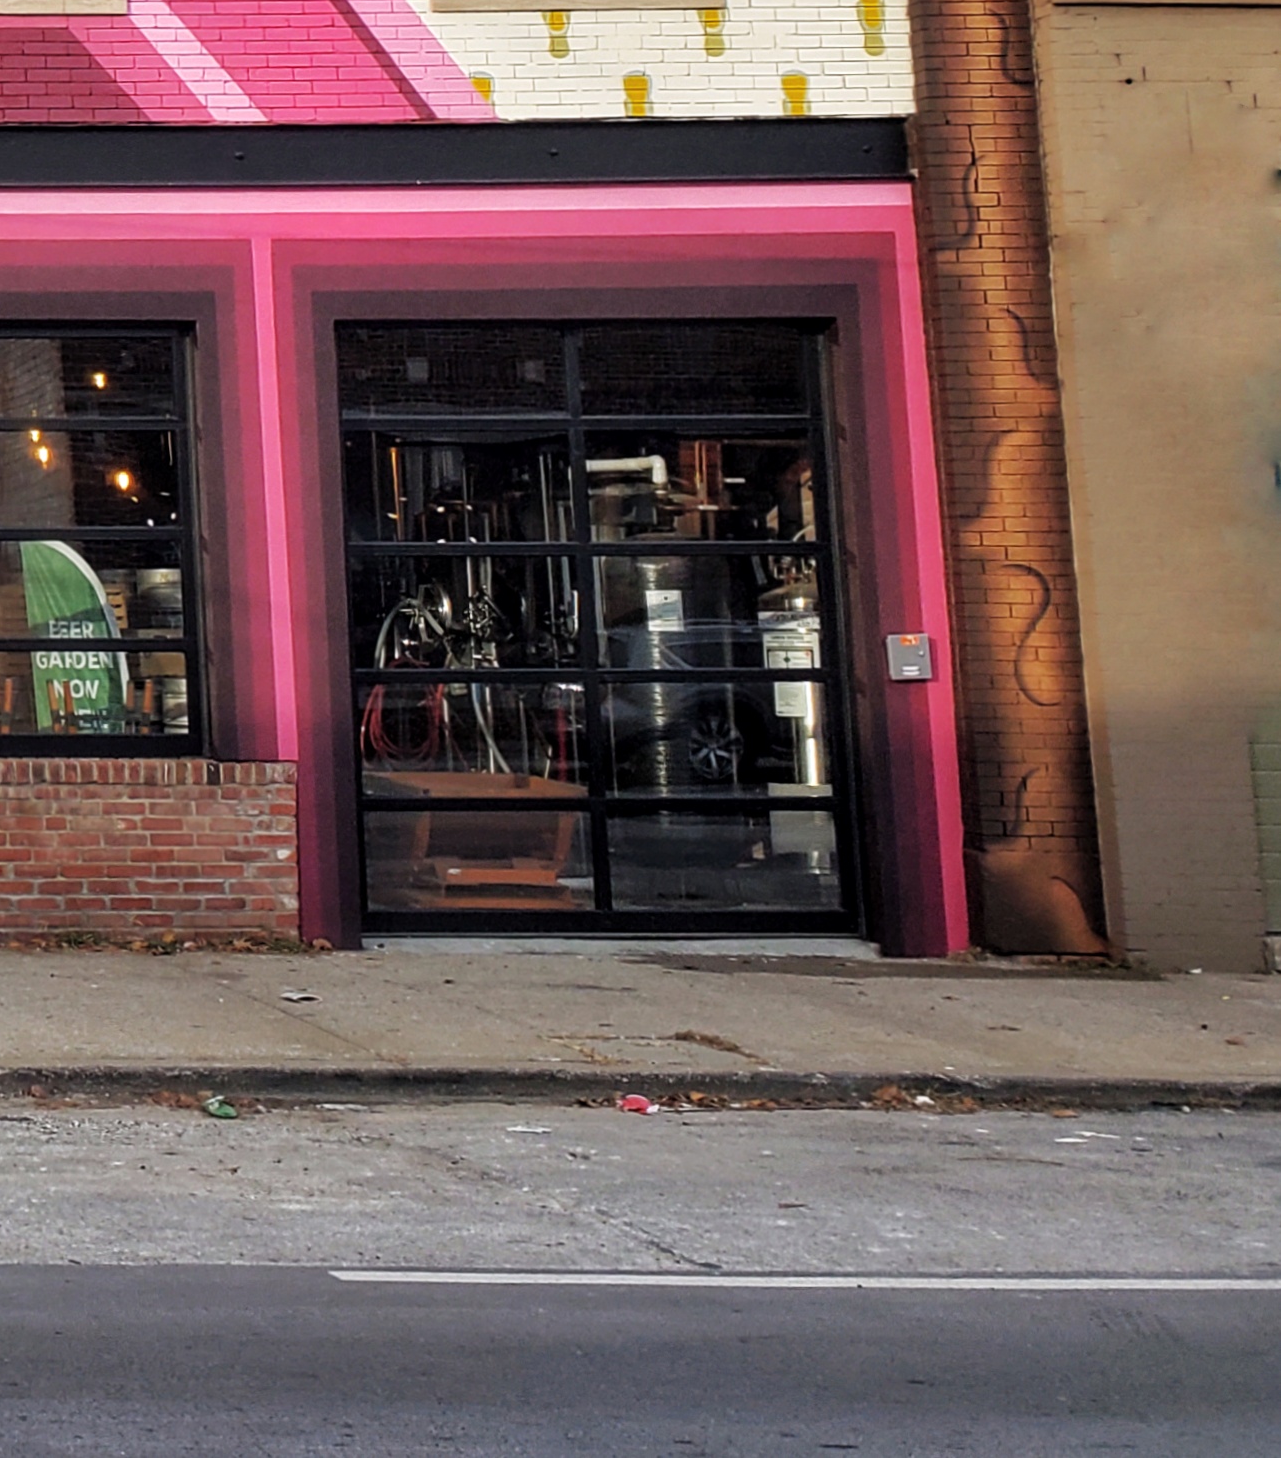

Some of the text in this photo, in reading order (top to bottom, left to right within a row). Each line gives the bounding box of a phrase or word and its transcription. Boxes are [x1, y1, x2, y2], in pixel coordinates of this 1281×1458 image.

[48, 620, 94, 638] BEER
[36, 651, 114, 669] GARDEN
[53, 679, 100, 700] NOW
